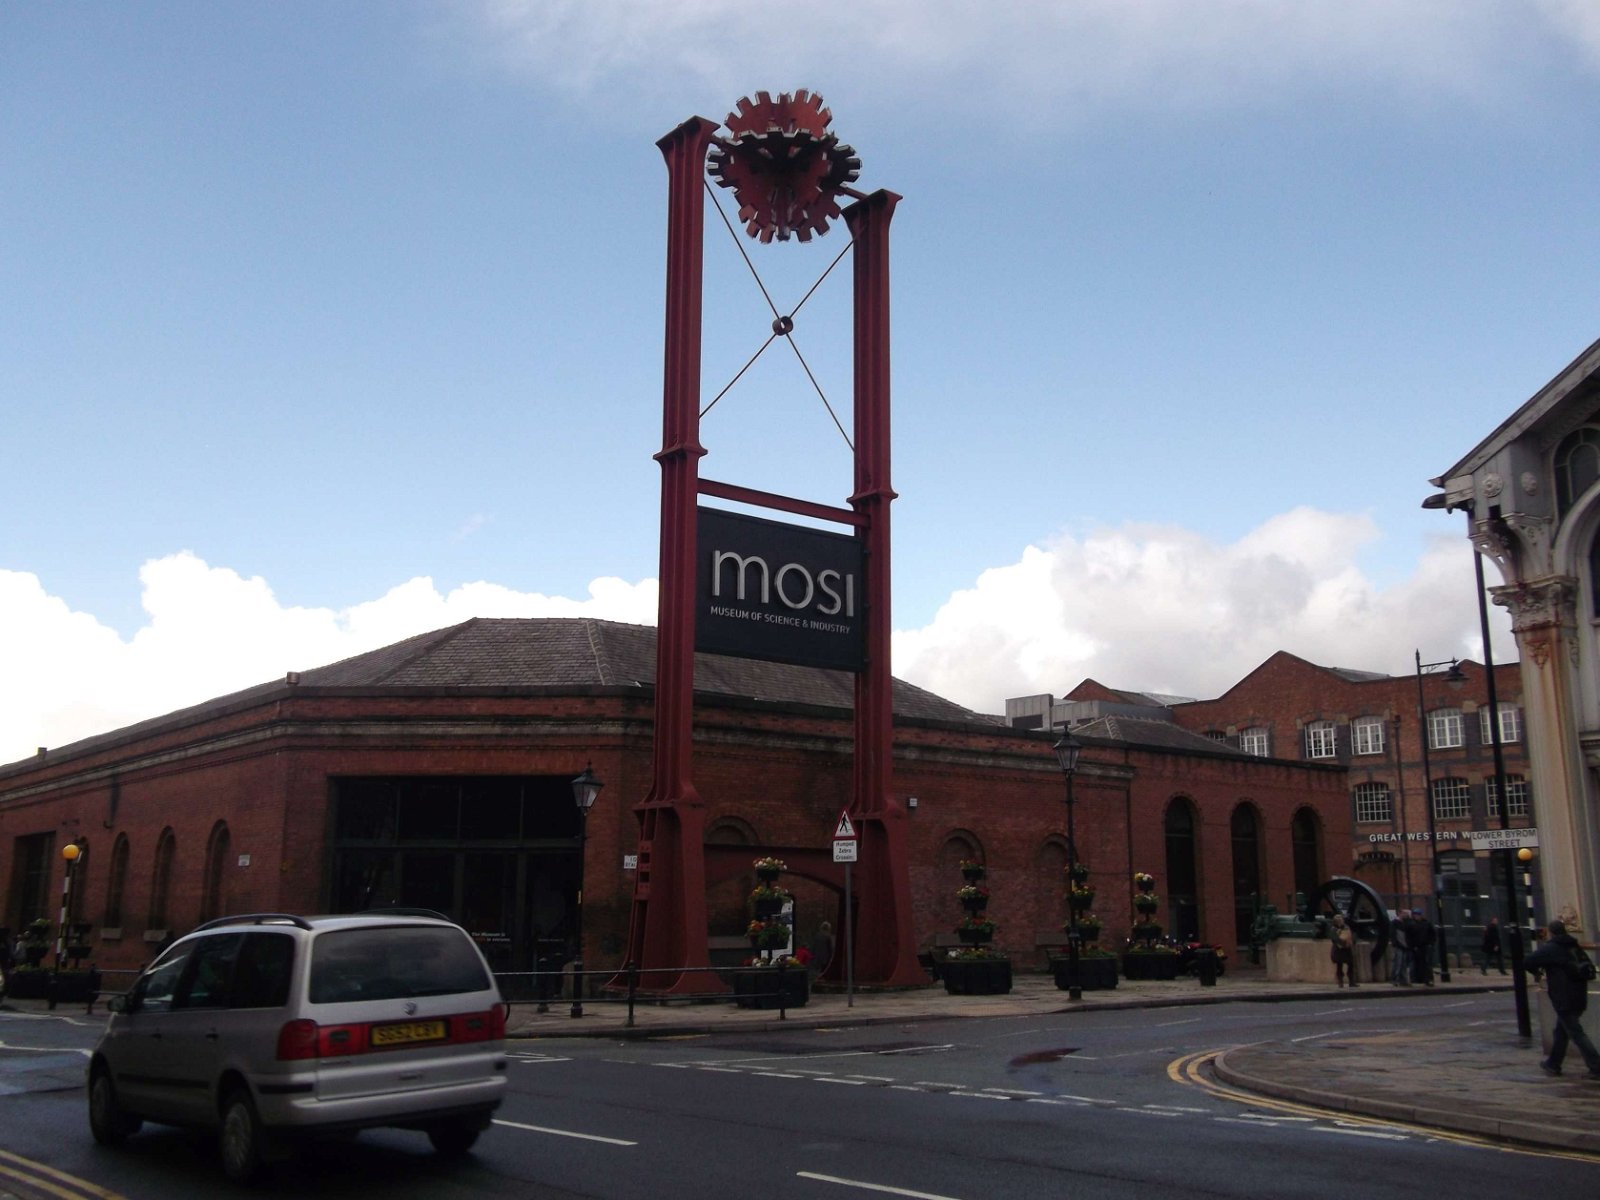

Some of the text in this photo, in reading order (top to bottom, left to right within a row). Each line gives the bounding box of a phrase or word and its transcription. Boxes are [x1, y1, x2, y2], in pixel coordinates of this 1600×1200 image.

[710, 606, 851, 634] MUSEUM OF SCIENCE & INDUSTRY
[1369, 833, 1402, 842] GREAT
[1407, 831, 1457, 841] WESERN
[1473, 828, 1537, 840] LOWER BYROM
[1488, 839, 1520, 848] STREET
